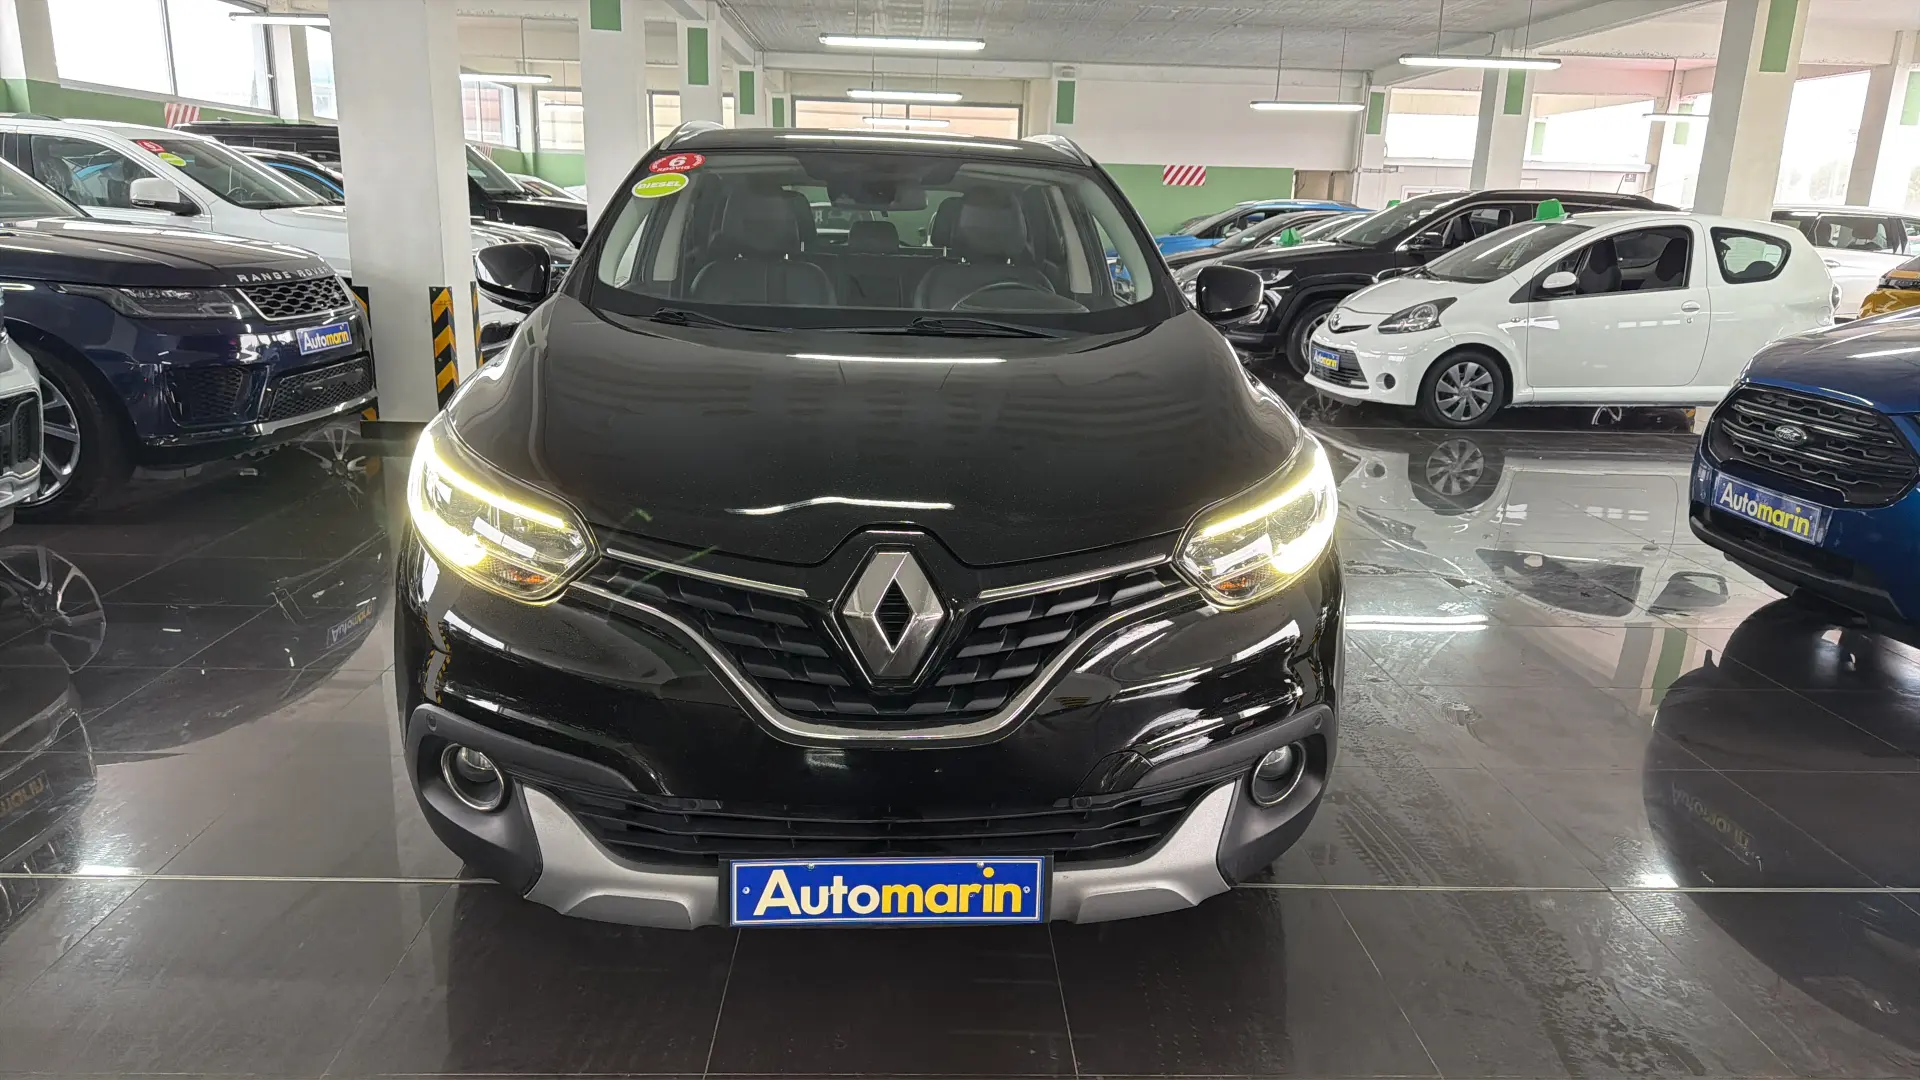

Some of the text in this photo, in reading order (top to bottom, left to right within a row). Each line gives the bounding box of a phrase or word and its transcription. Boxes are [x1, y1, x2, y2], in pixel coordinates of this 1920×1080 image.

[669, 155, 687, 167] 6
[637, 180, 681, 190] DIESEL
[236, 266, 330, 283] RANGE ROVER
[303, 330, 350, 351] Automarin
[1719, 481, 1810, 536] Automarin
[753, 866, 1022, 916] Automarin
